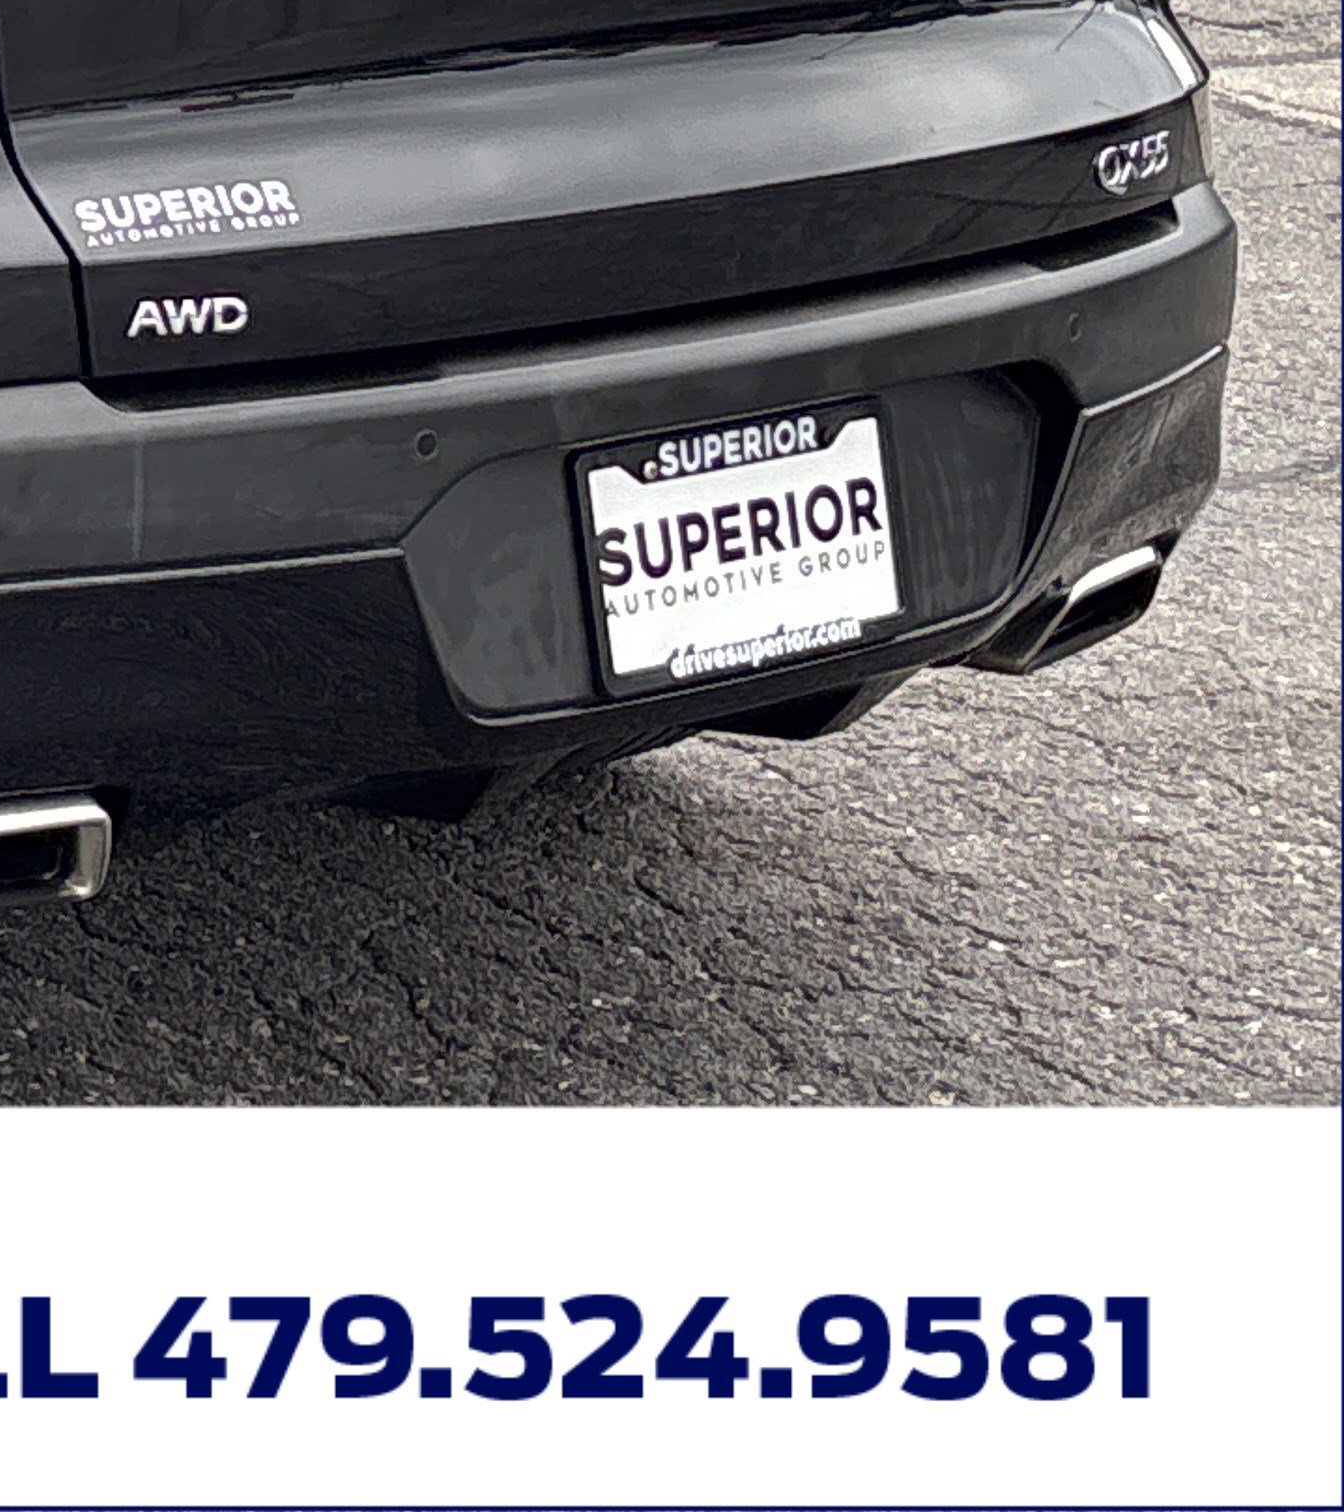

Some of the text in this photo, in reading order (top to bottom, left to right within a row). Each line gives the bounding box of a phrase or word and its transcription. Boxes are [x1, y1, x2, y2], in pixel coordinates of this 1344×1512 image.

[1096, 130, 1171, 196] QX55
[74, 180, 296, 233] SUPERIOR
[86, 212, 301, 249] AUTOMOTIVE GROUP
[127, 296, 249, 338] AWD
[658, 415, 818, 477] SUPERIOR
[597, 476, 883, 587] SUPERIOR
[605, 540, 886, 619] AUTOMOTIVE GROUP
[669, 617, 862, 679] drivesuperior.com
